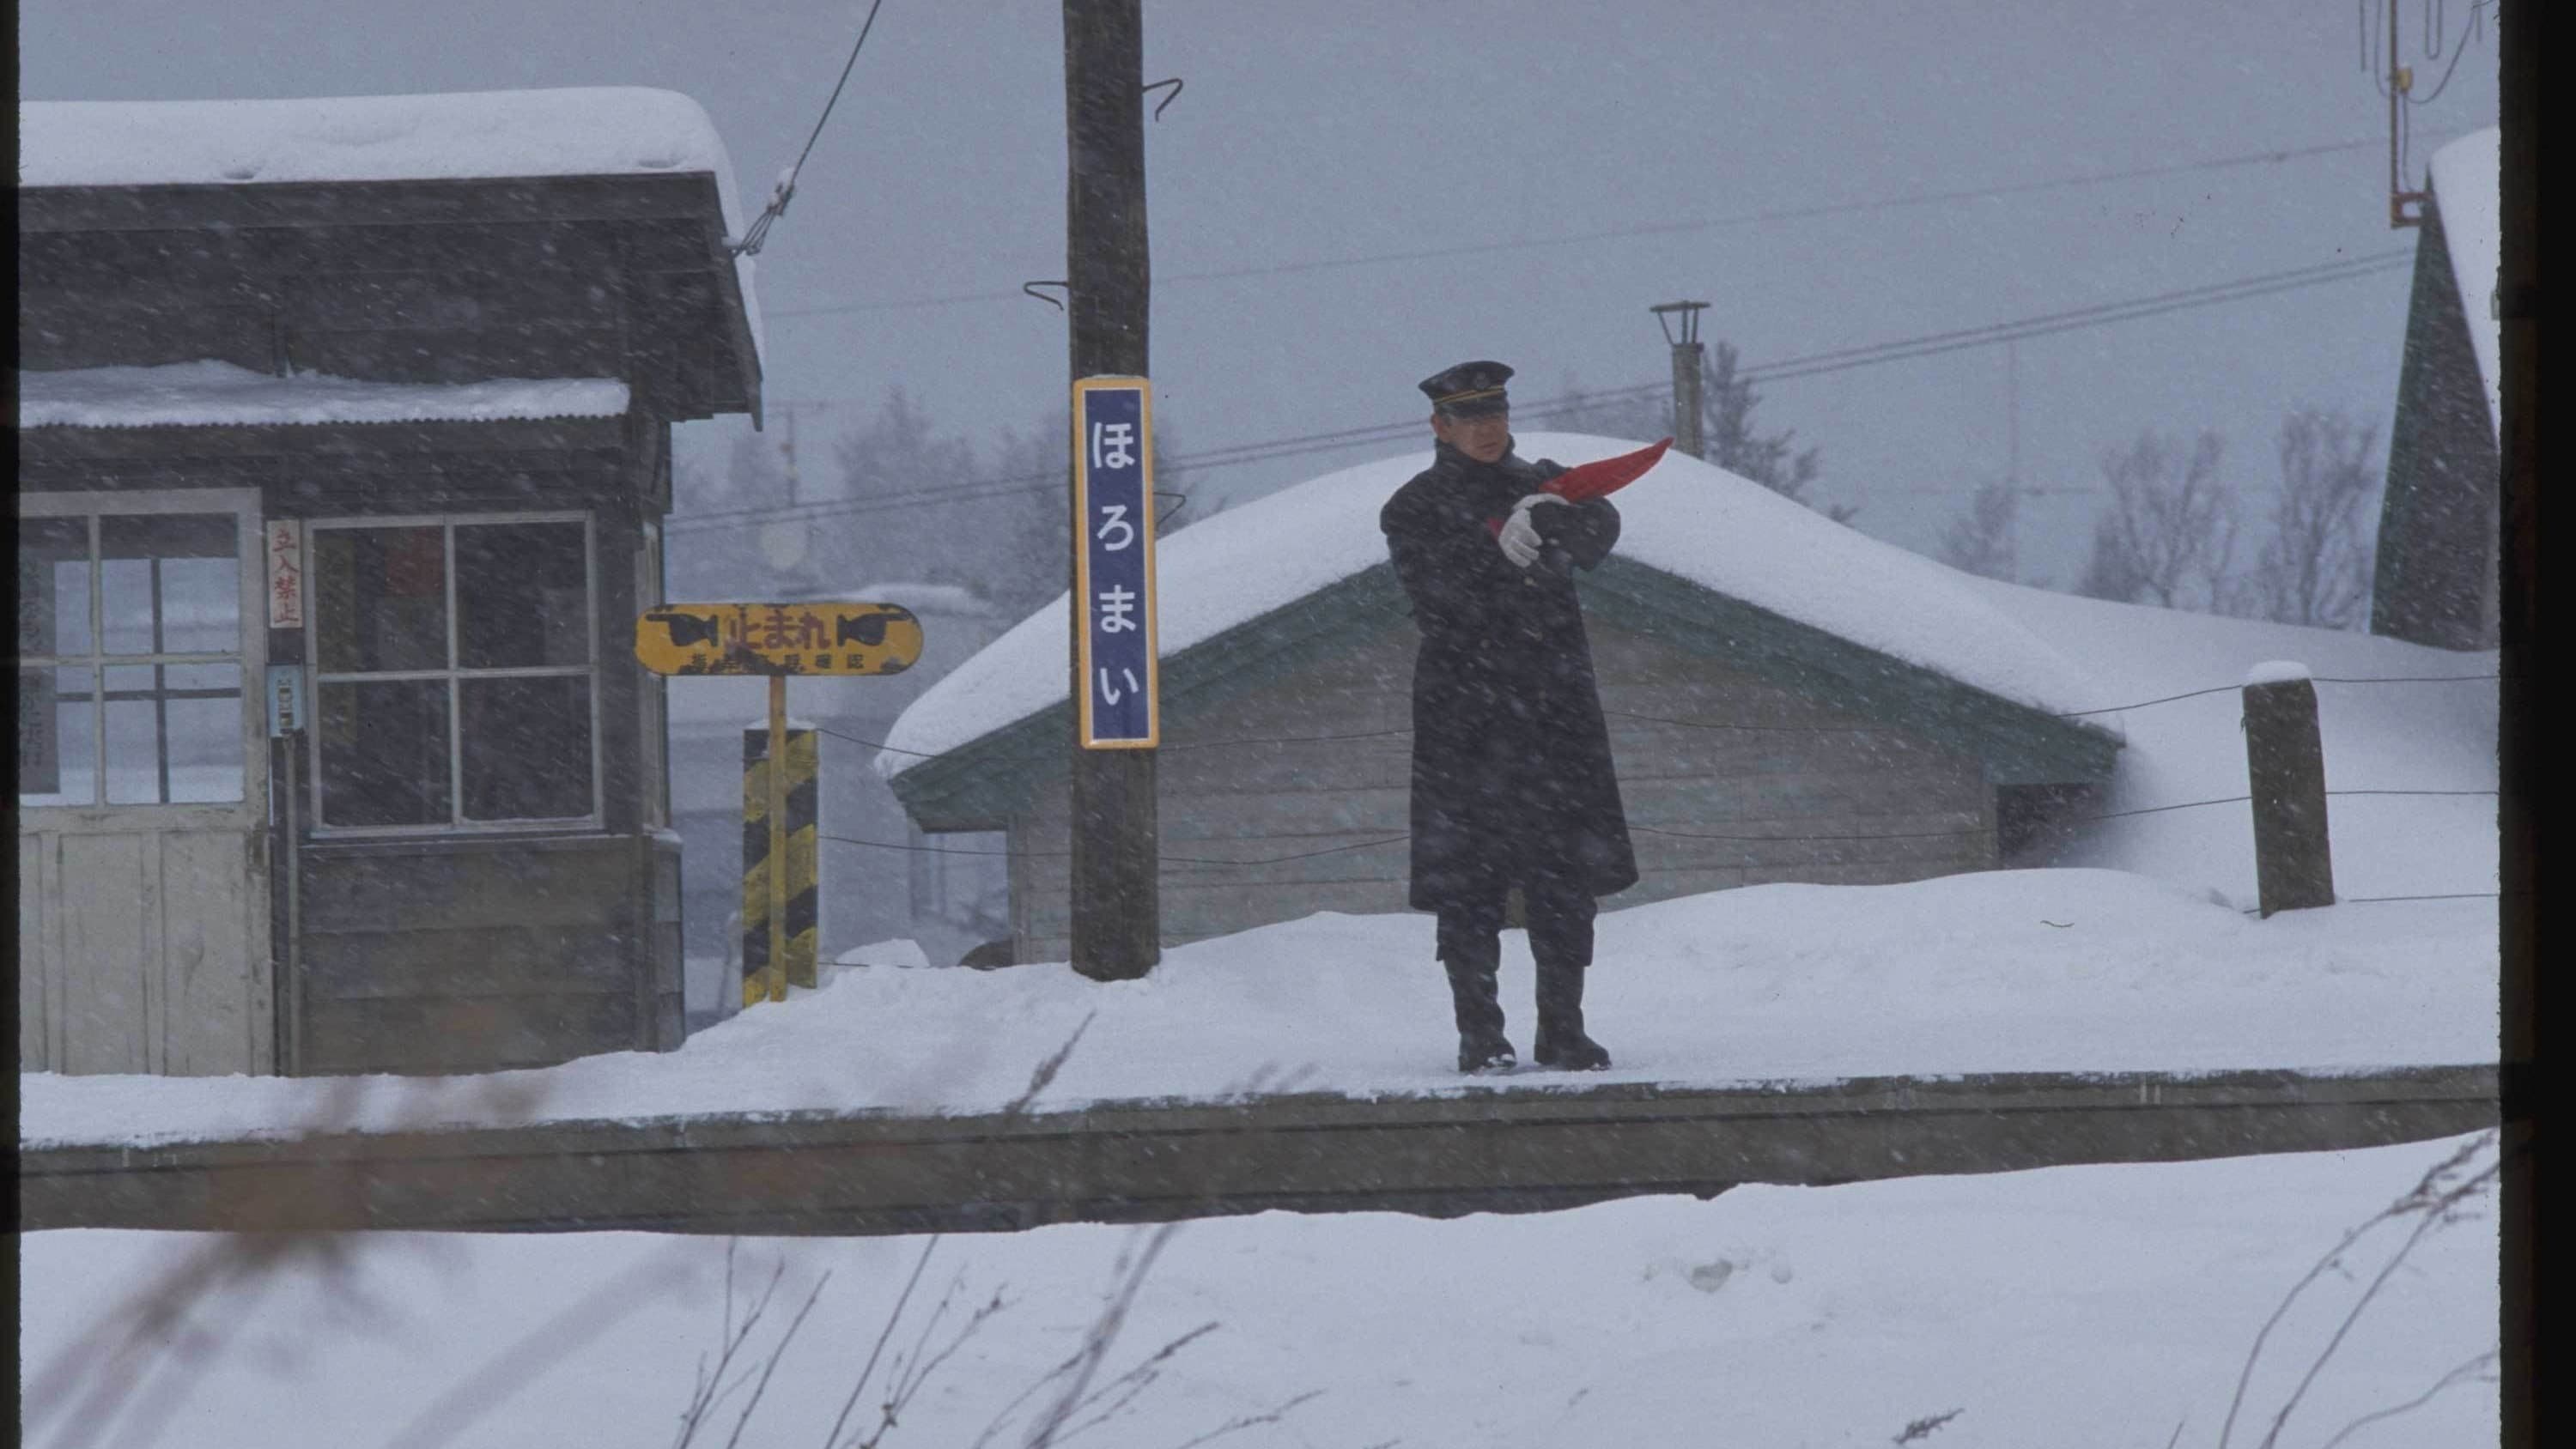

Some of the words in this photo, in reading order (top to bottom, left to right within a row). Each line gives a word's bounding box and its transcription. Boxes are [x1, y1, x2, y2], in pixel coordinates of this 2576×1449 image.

[271, 528, 301, 623] 立入禁止
[1092, 421, 1139, 706] ほろまい
[723, 605, 831, 650] 止まれ
